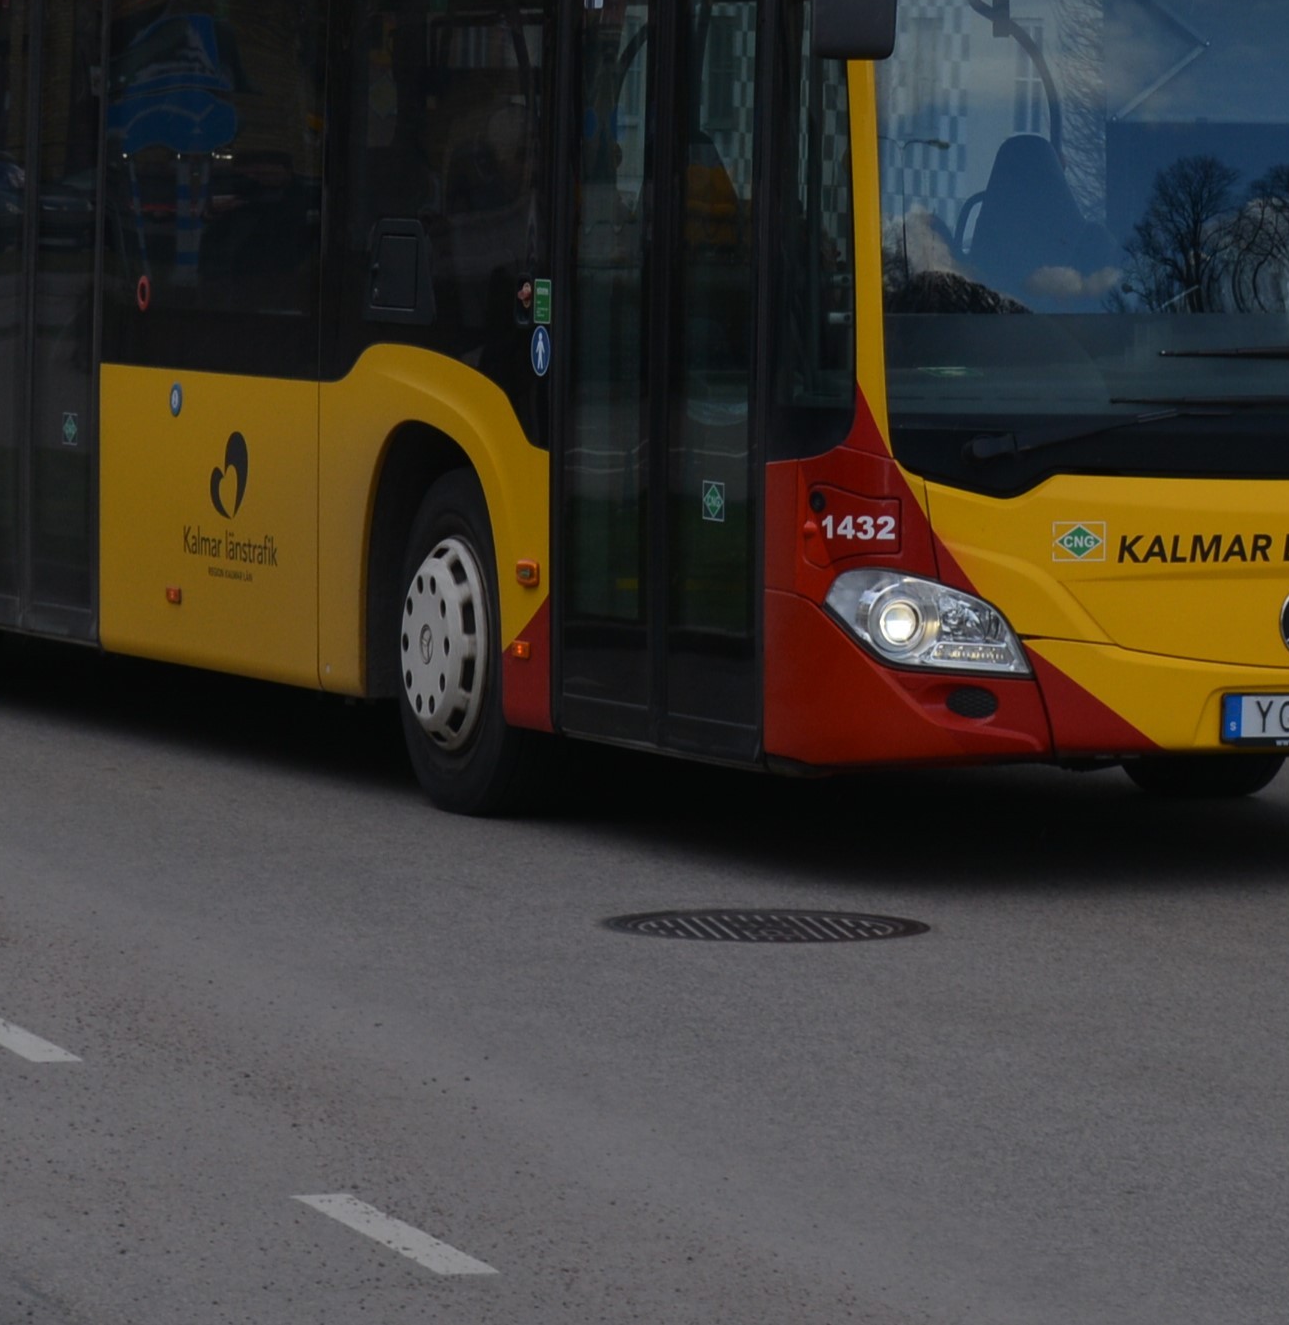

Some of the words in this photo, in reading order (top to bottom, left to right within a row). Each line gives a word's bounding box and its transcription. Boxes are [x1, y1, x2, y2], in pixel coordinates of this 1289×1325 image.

[705, 493, 722, 508] CNG
[822, 515, 896, 540] 1432
[183, 526, 222, 558] Kalmar
[225, 530, 278, 567] länstrafik
[1063, 535, 1096, 549] CNG
[1117, 534, 1272, 564] KALMAR
